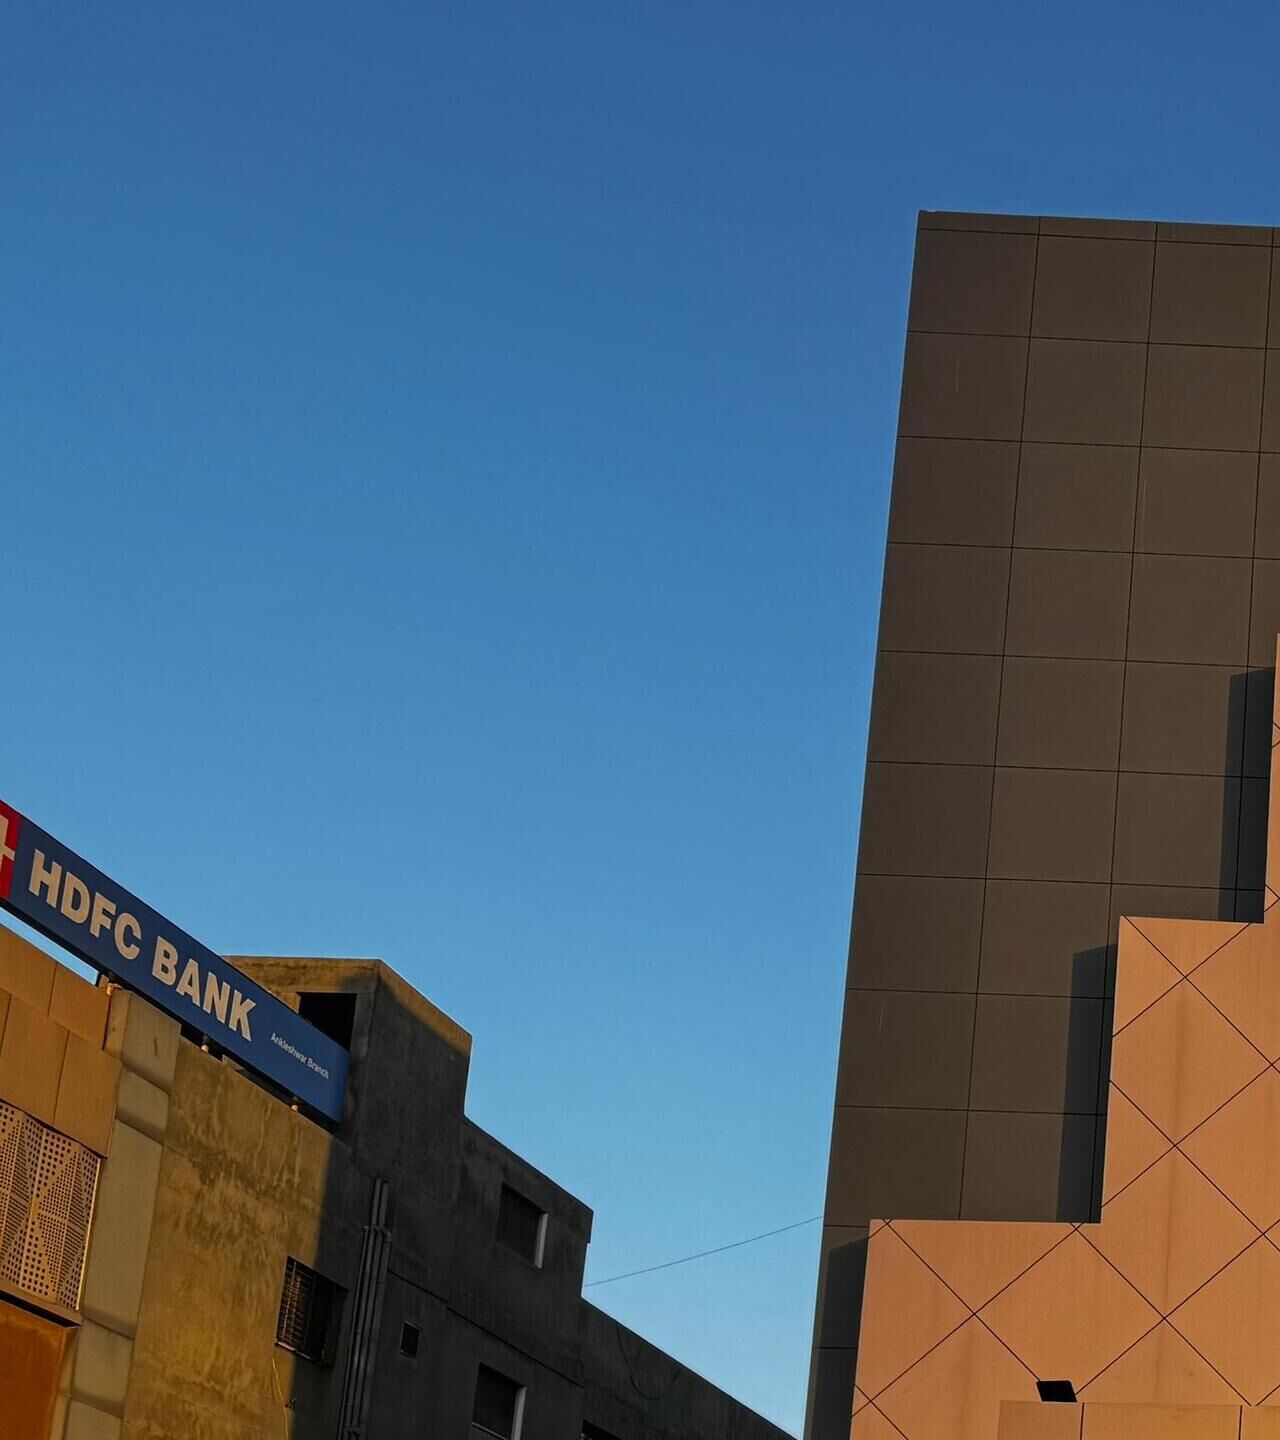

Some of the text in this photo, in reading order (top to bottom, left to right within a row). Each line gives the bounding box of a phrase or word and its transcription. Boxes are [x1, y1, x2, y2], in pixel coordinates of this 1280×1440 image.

[28, 848, 256, 1042] HDFC BANK
[307, 1057, 329, 1080] Branch
